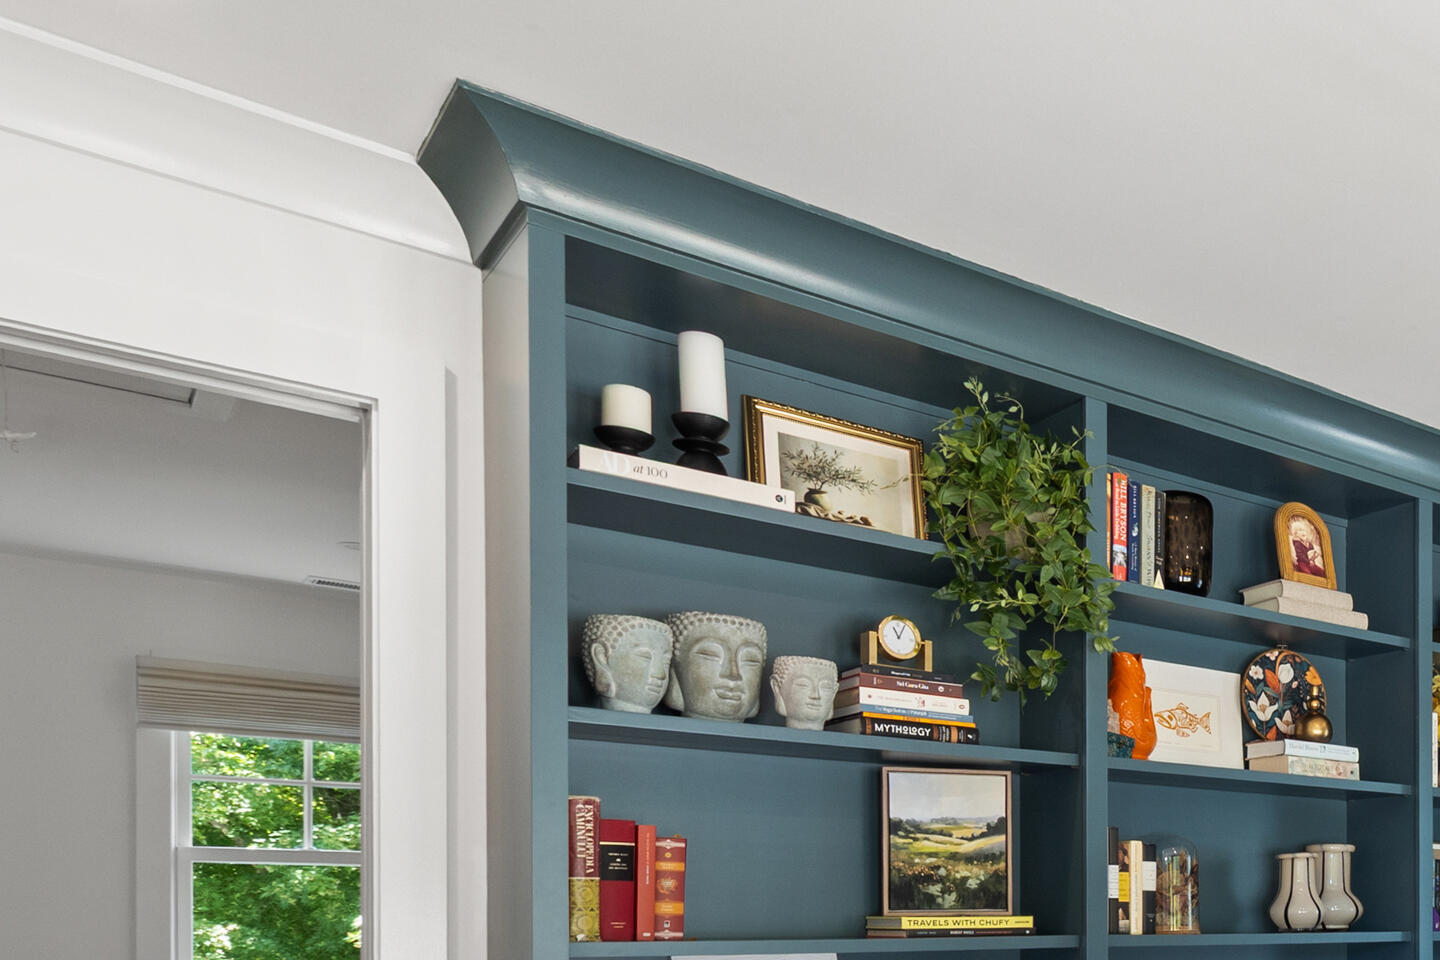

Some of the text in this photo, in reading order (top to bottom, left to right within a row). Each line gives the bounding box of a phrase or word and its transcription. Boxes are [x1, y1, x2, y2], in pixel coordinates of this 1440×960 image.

[633, 464, 644, 475] at
[646, 466, 669, 480] 100
[1120, 501, 1128, 541] BRYSON
[874, 723, 931, 737] MYTHOLOGY
[908, 919, 949, 927] TRAVELS
[952, 919, 976, 927] WITH
